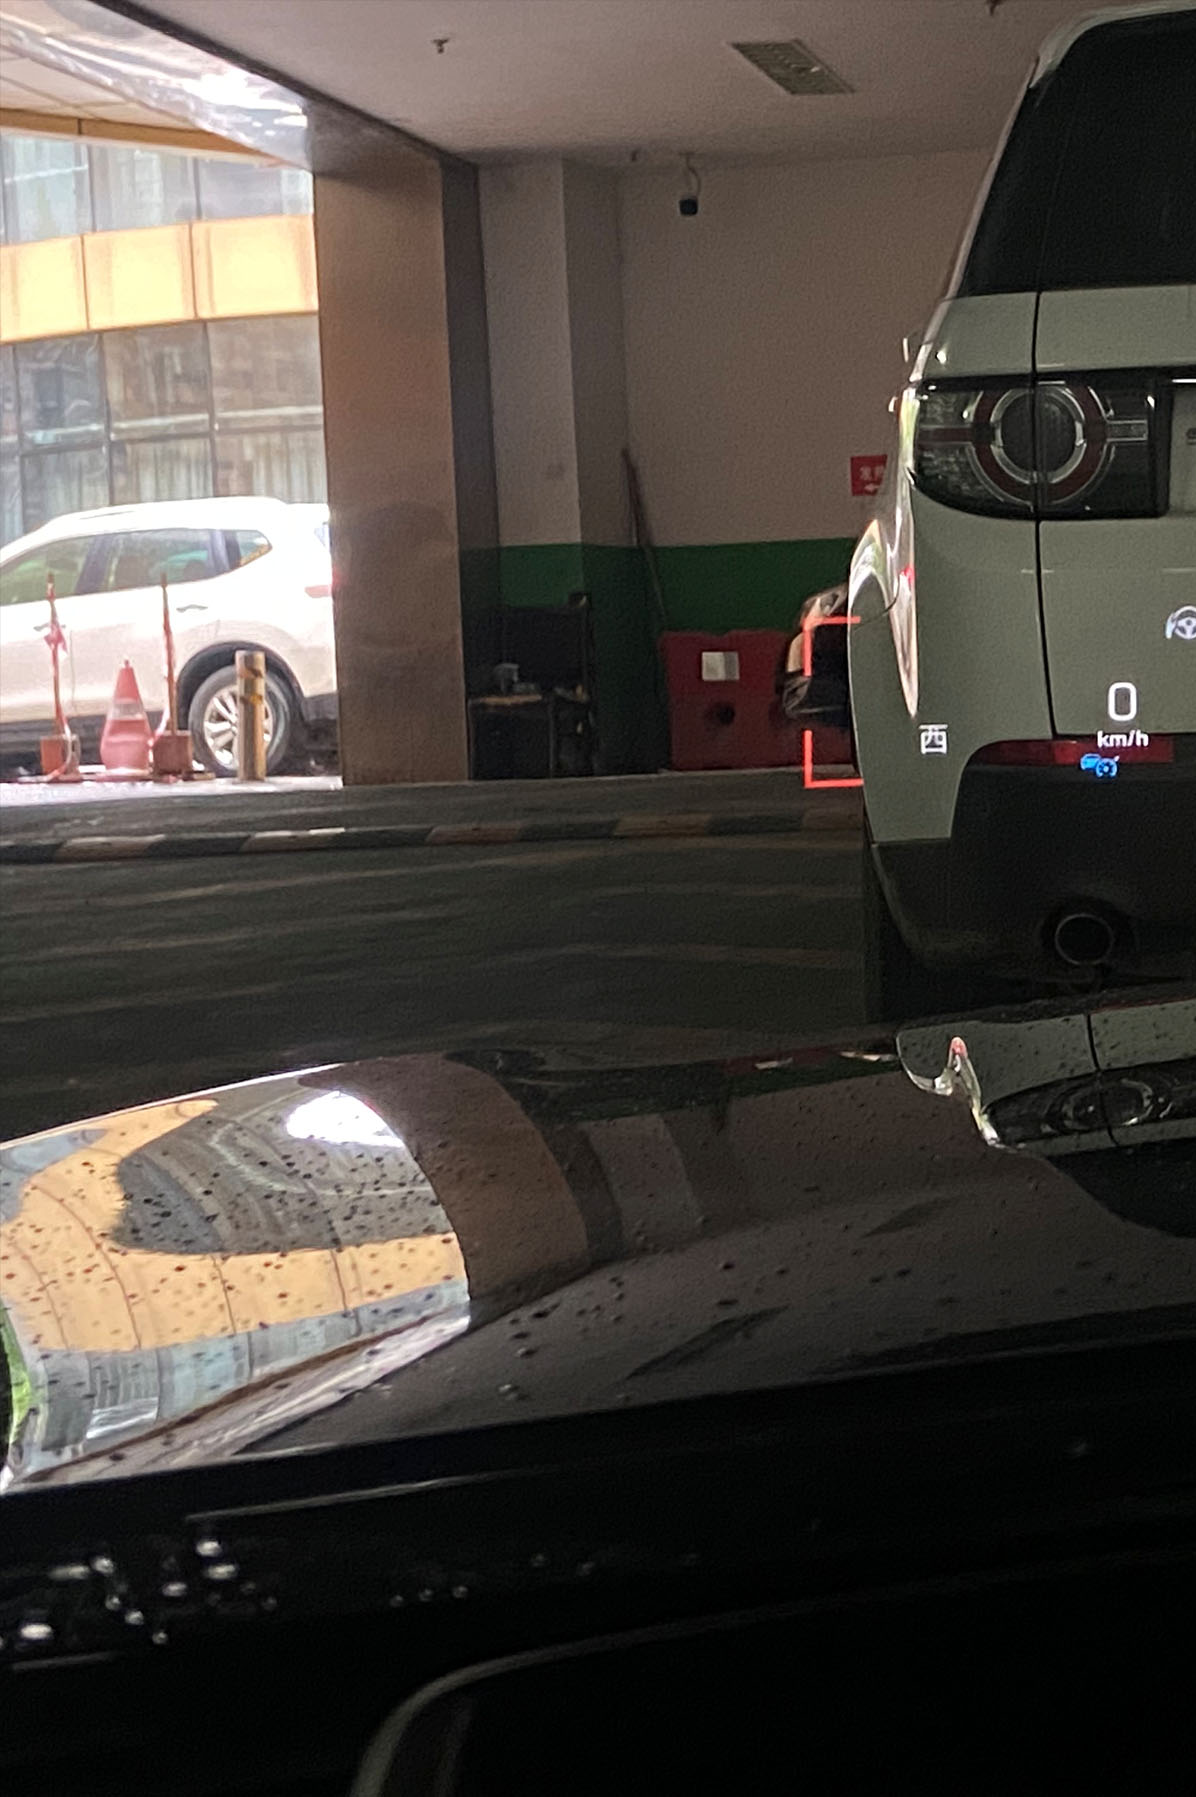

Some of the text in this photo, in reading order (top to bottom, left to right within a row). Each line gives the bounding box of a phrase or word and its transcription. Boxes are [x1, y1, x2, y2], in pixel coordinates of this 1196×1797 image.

[1107, 681, 1138, 722] 0
[918, 723, 949, 755] 西
[1096, 728, 1150, 748] km/h
